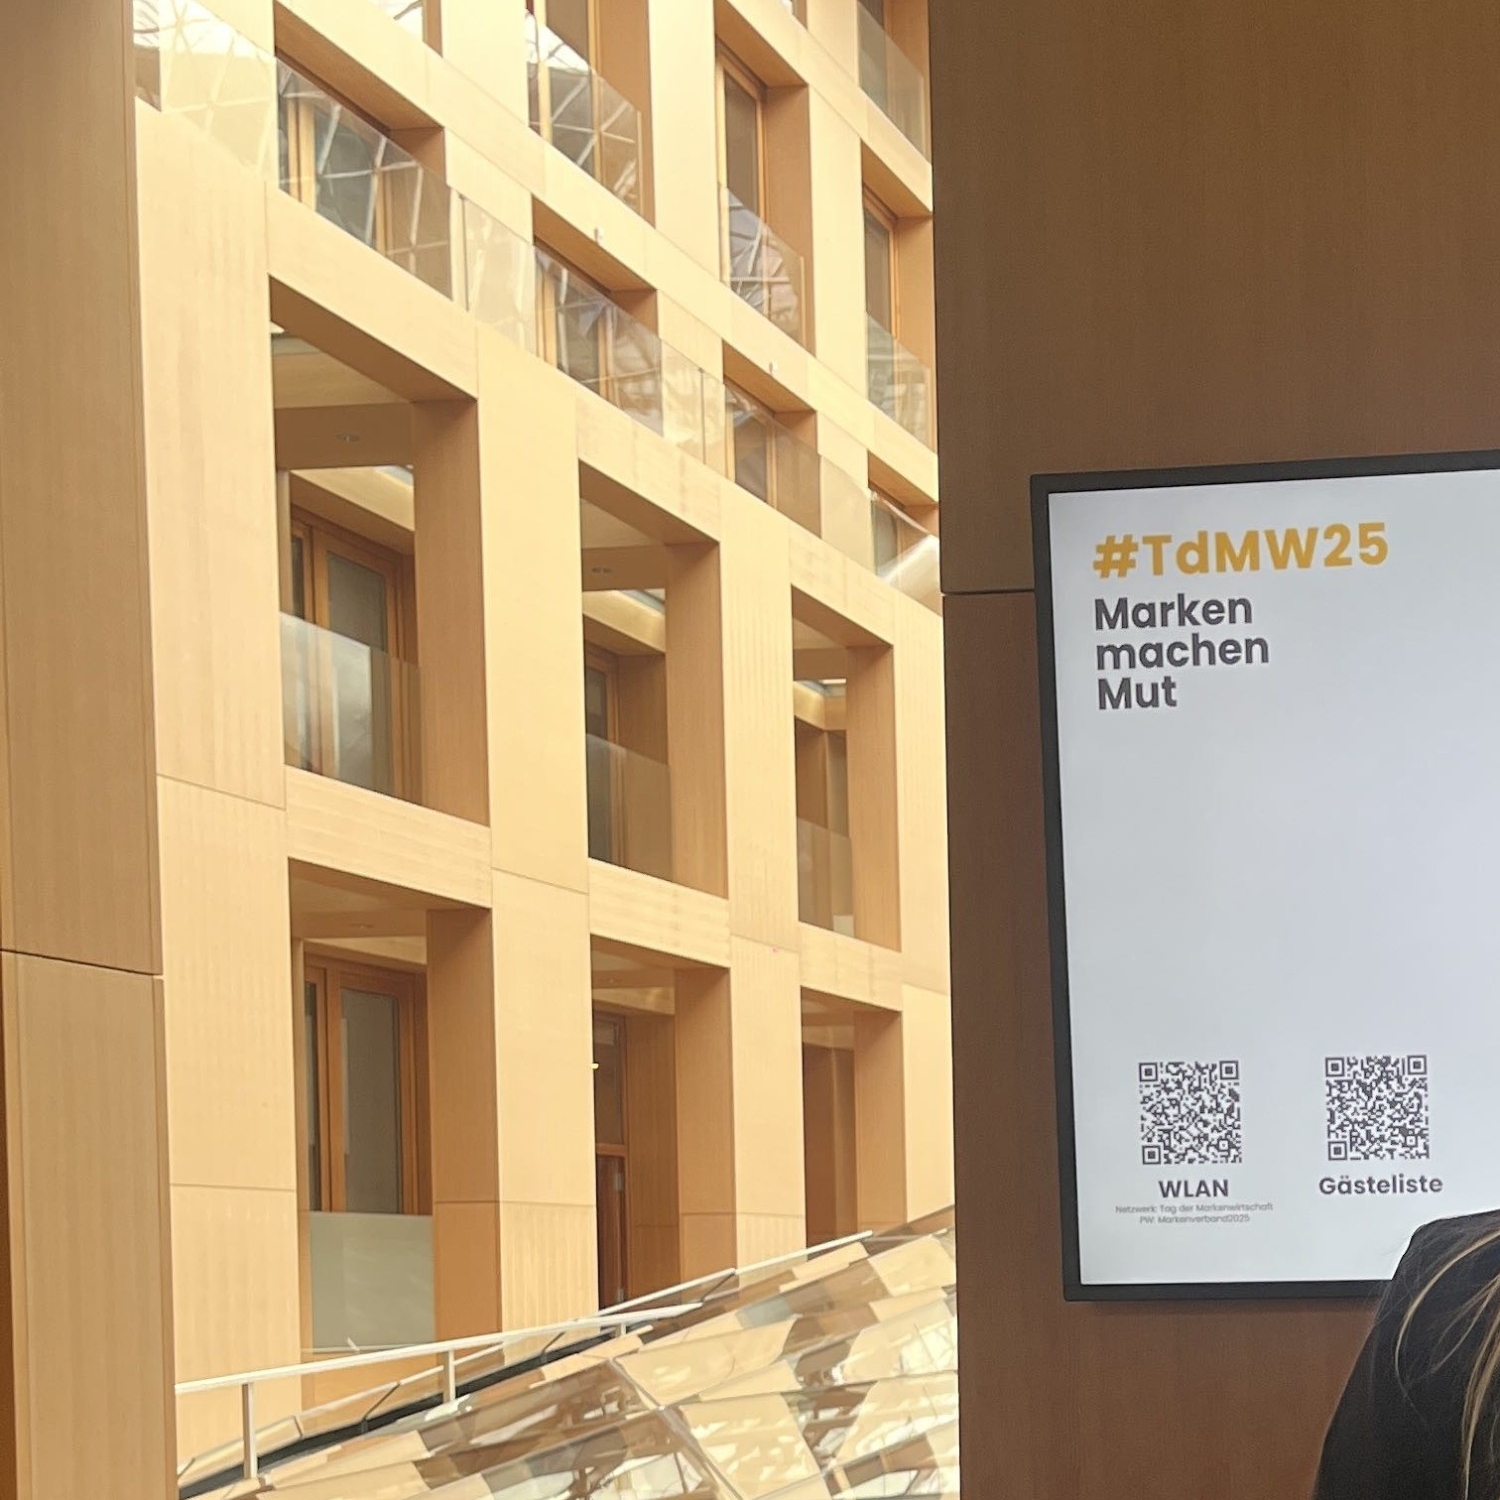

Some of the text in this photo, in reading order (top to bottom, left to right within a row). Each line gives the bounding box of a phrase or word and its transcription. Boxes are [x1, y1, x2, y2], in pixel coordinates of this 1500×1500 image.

[1093, 522, 1389, 579] #TdMW25
[1094, 593, 1253, 630] Marken
[1096, 633, 1269, 670] machen
[1097, 675, 1178, 710] Mut
[1158, 1179, 1230, 1199] WLAN
[1318, 1172, 1444, 1196] Gästeliste
[1160, 1204, 1177, 1215] Tag
[1179, 1204, 1193, 1213] der
[1195, 1202, 1274, 1212] Markenwirtschaft
